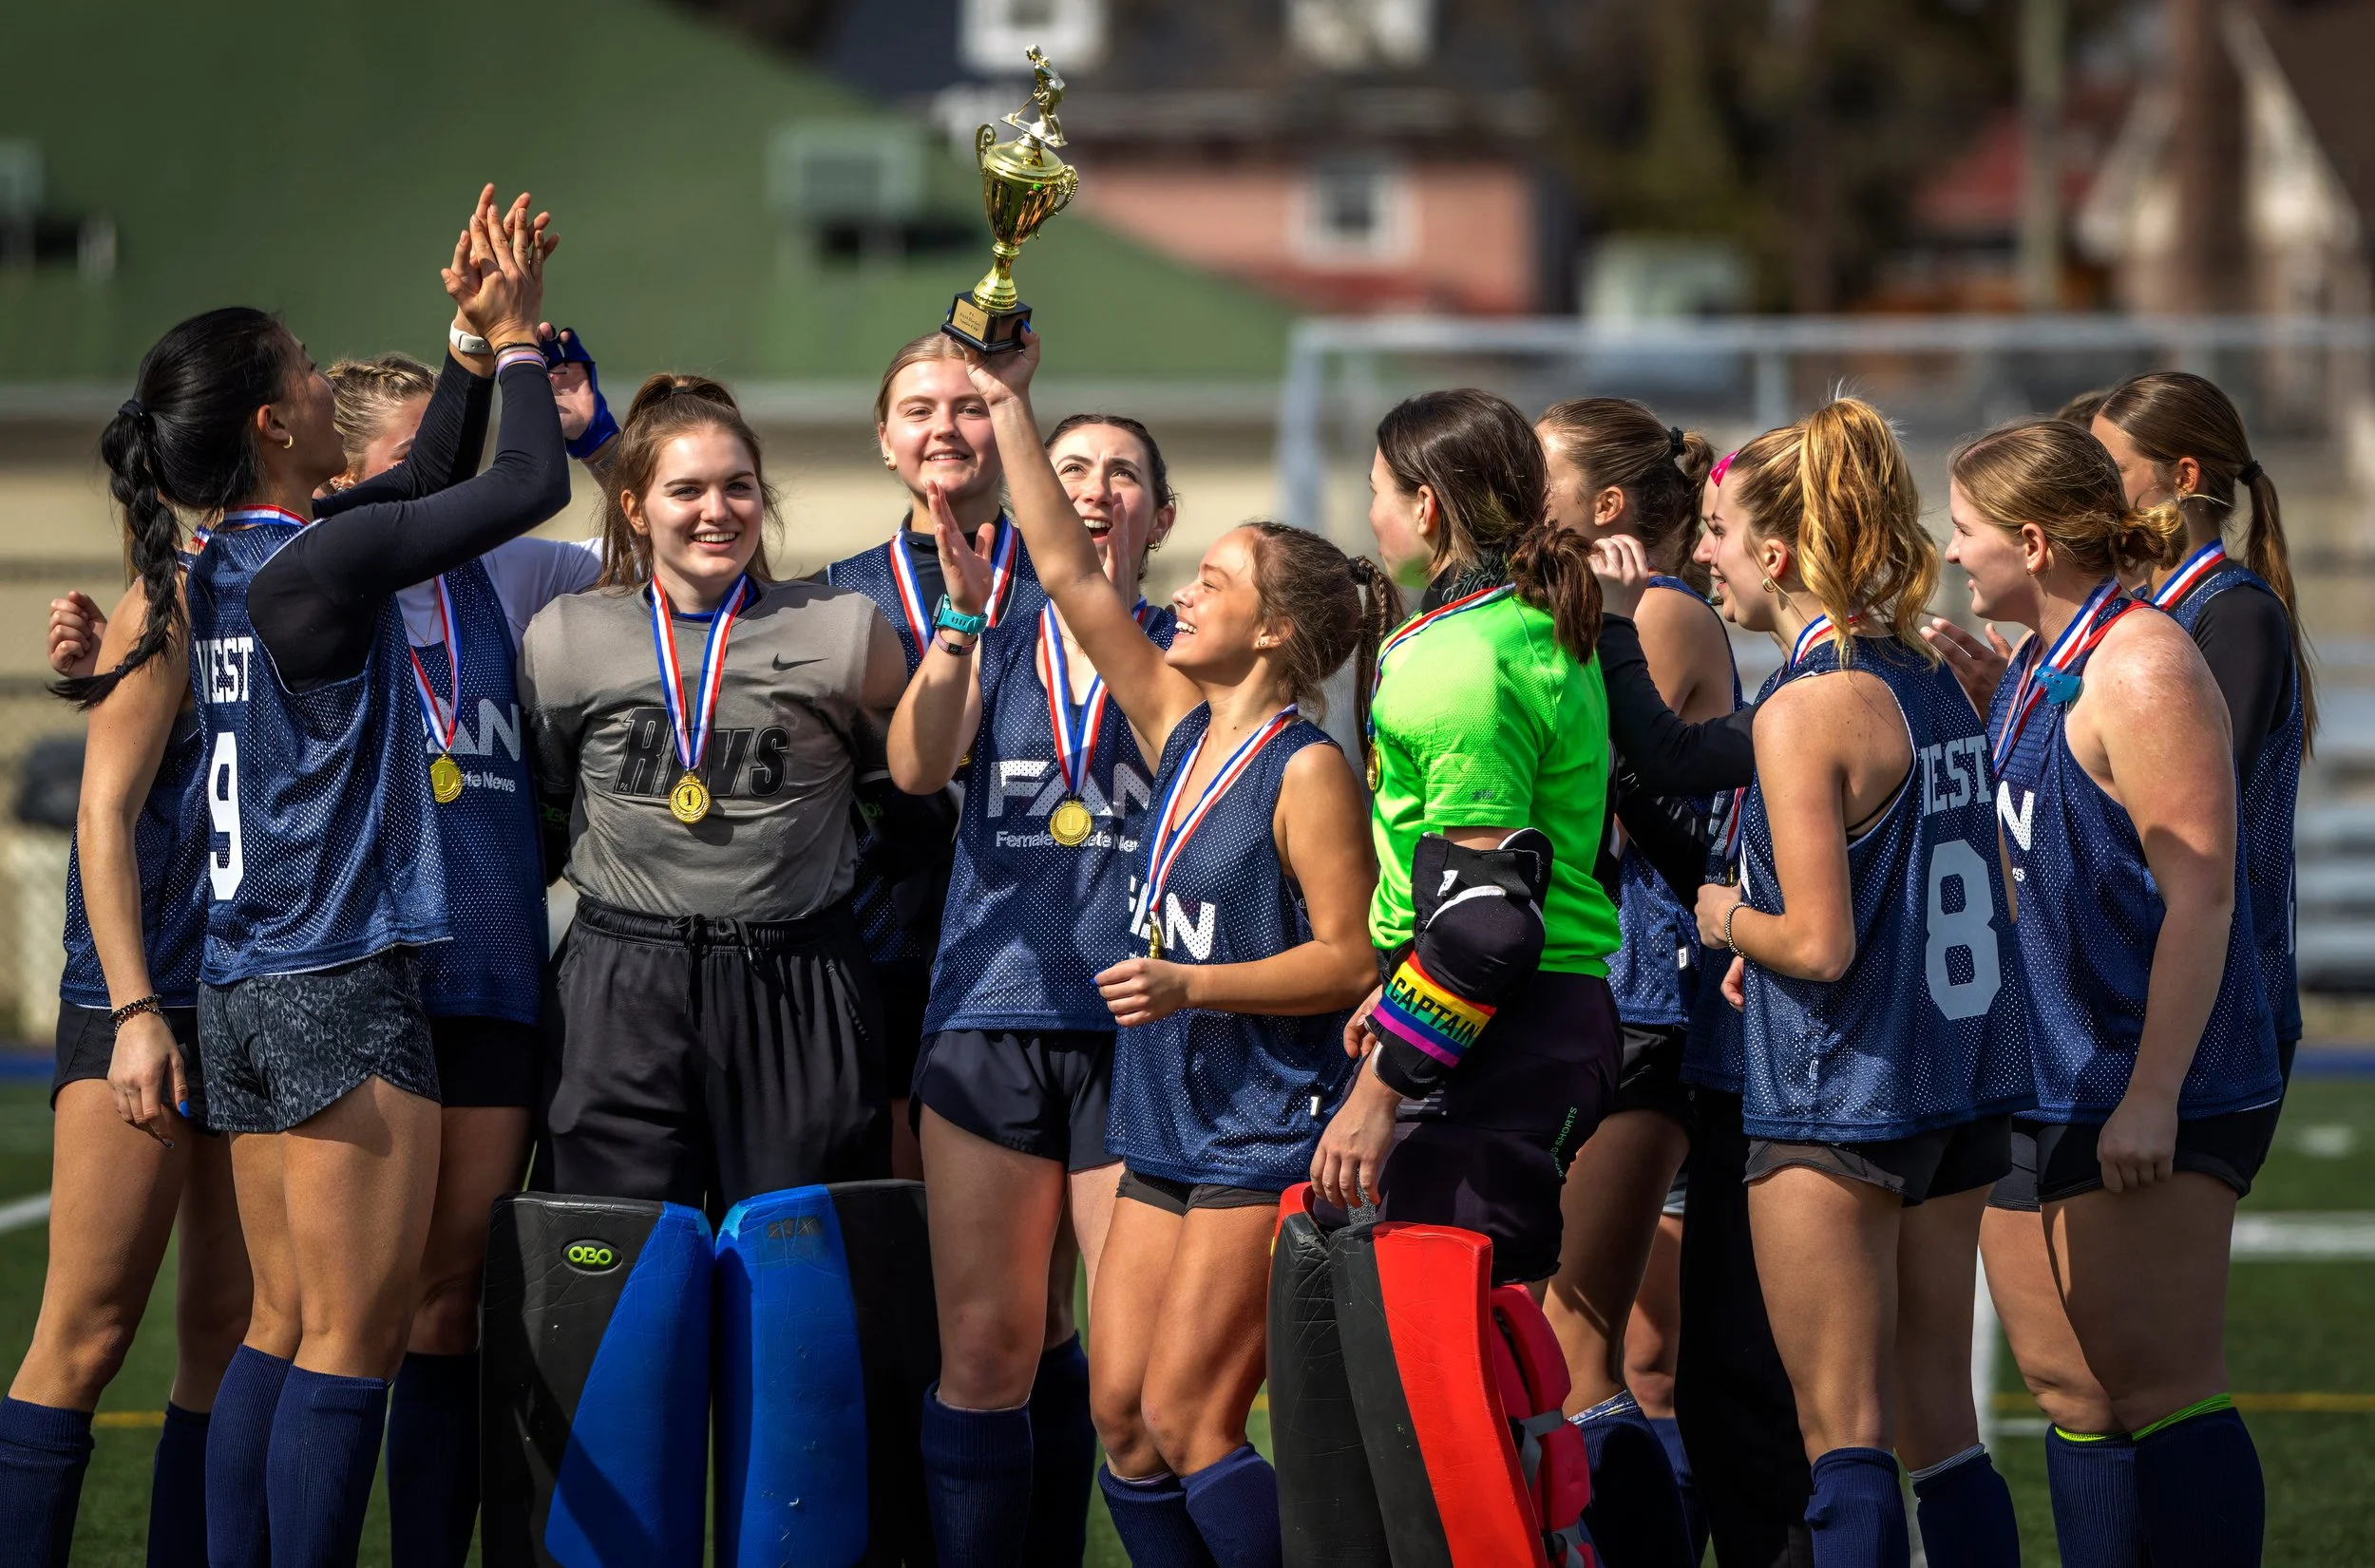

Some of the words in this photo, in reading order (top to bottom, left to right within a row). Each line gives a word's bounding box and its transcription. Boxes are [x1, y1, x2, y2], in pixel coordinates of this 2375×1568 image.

[422, 696, 521, 762] AN
[438, 771, 447, 787] 1
[483, 771, 516, 792] News
[684, 788, 693, 807] 1
[208, 732, 243, 900] 9
[1067, 814, 1075, 831] 1
[996, 831, 1052, 848] Female
[1926, 839, 2002, 1021] 8
[1390, 977, 1481, 1048] CAPTAIN
[1555, 1106, 1578, 1146] SHORTS
[568, 1246, 613, 1265] OBO
